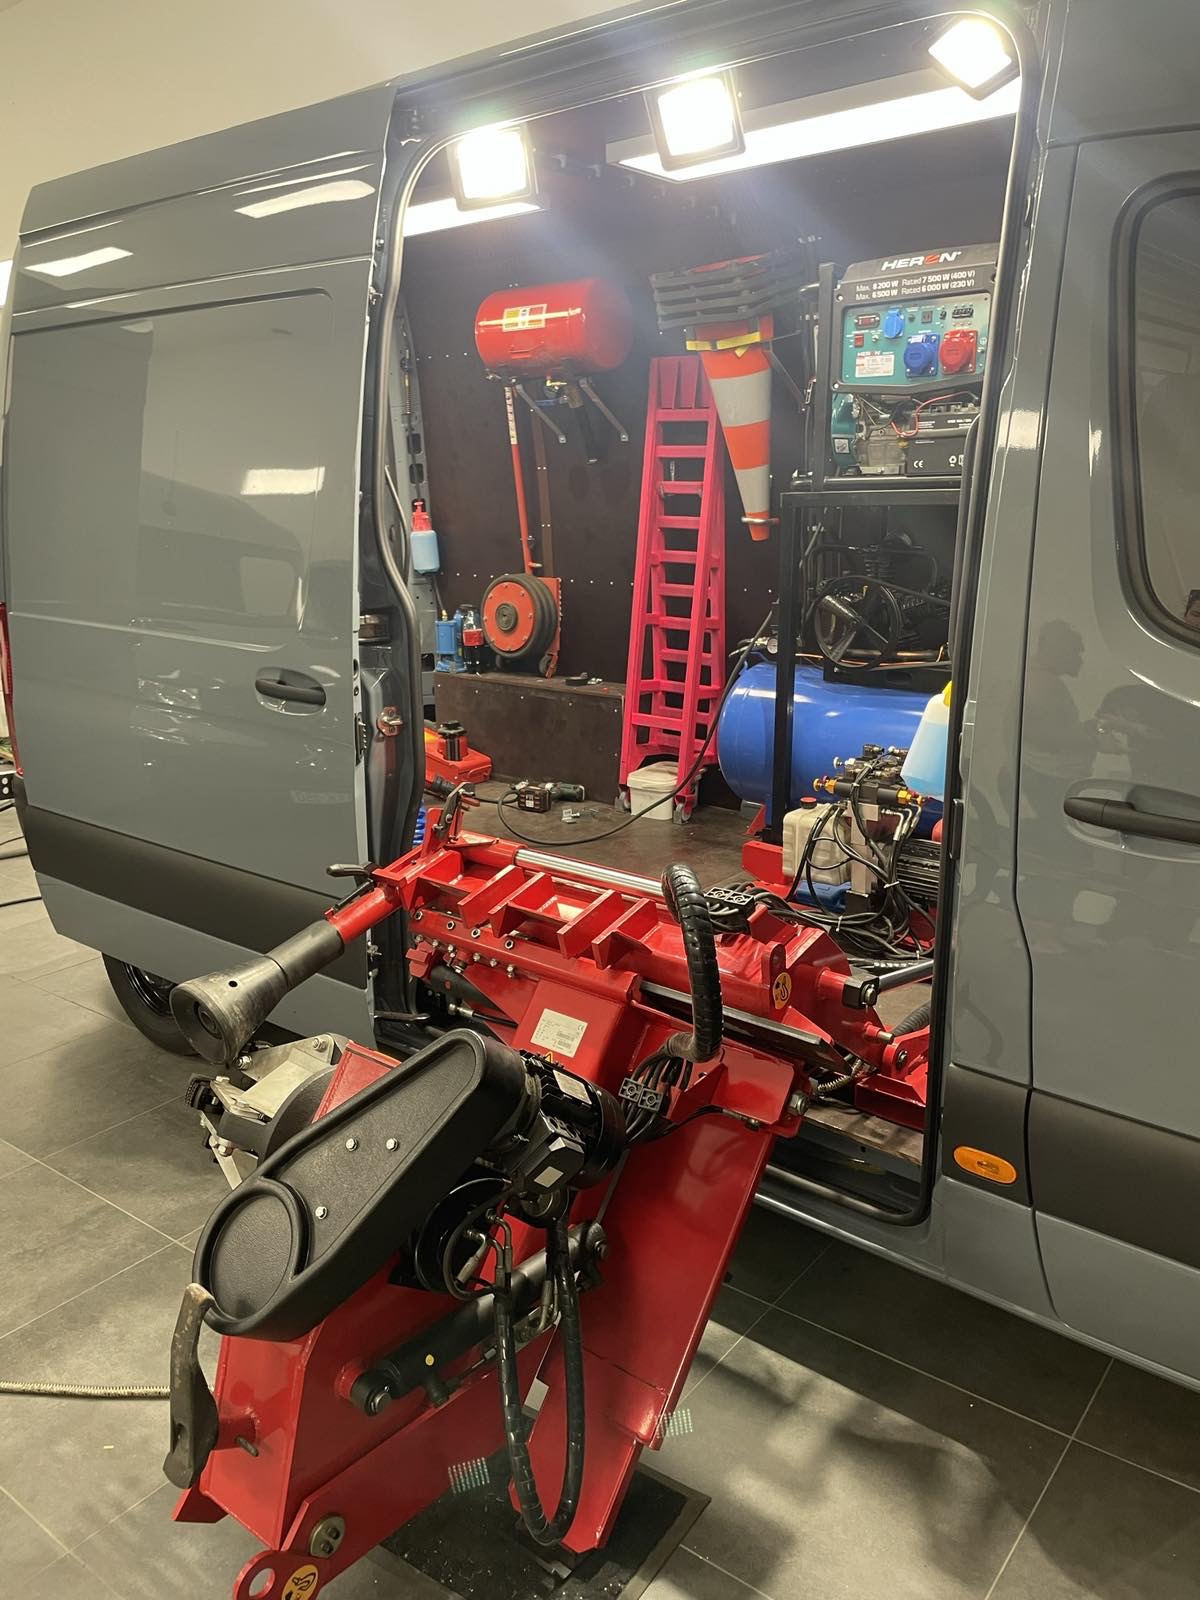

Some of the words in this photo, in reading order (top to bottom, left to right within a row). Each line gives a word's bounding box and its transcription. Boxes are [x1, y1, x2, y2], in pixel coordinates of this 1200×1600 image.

[881, 252, 960, 271] HERON
[902, 277, 922, 286] Rated
[901, 286, 921, 295] Rated
